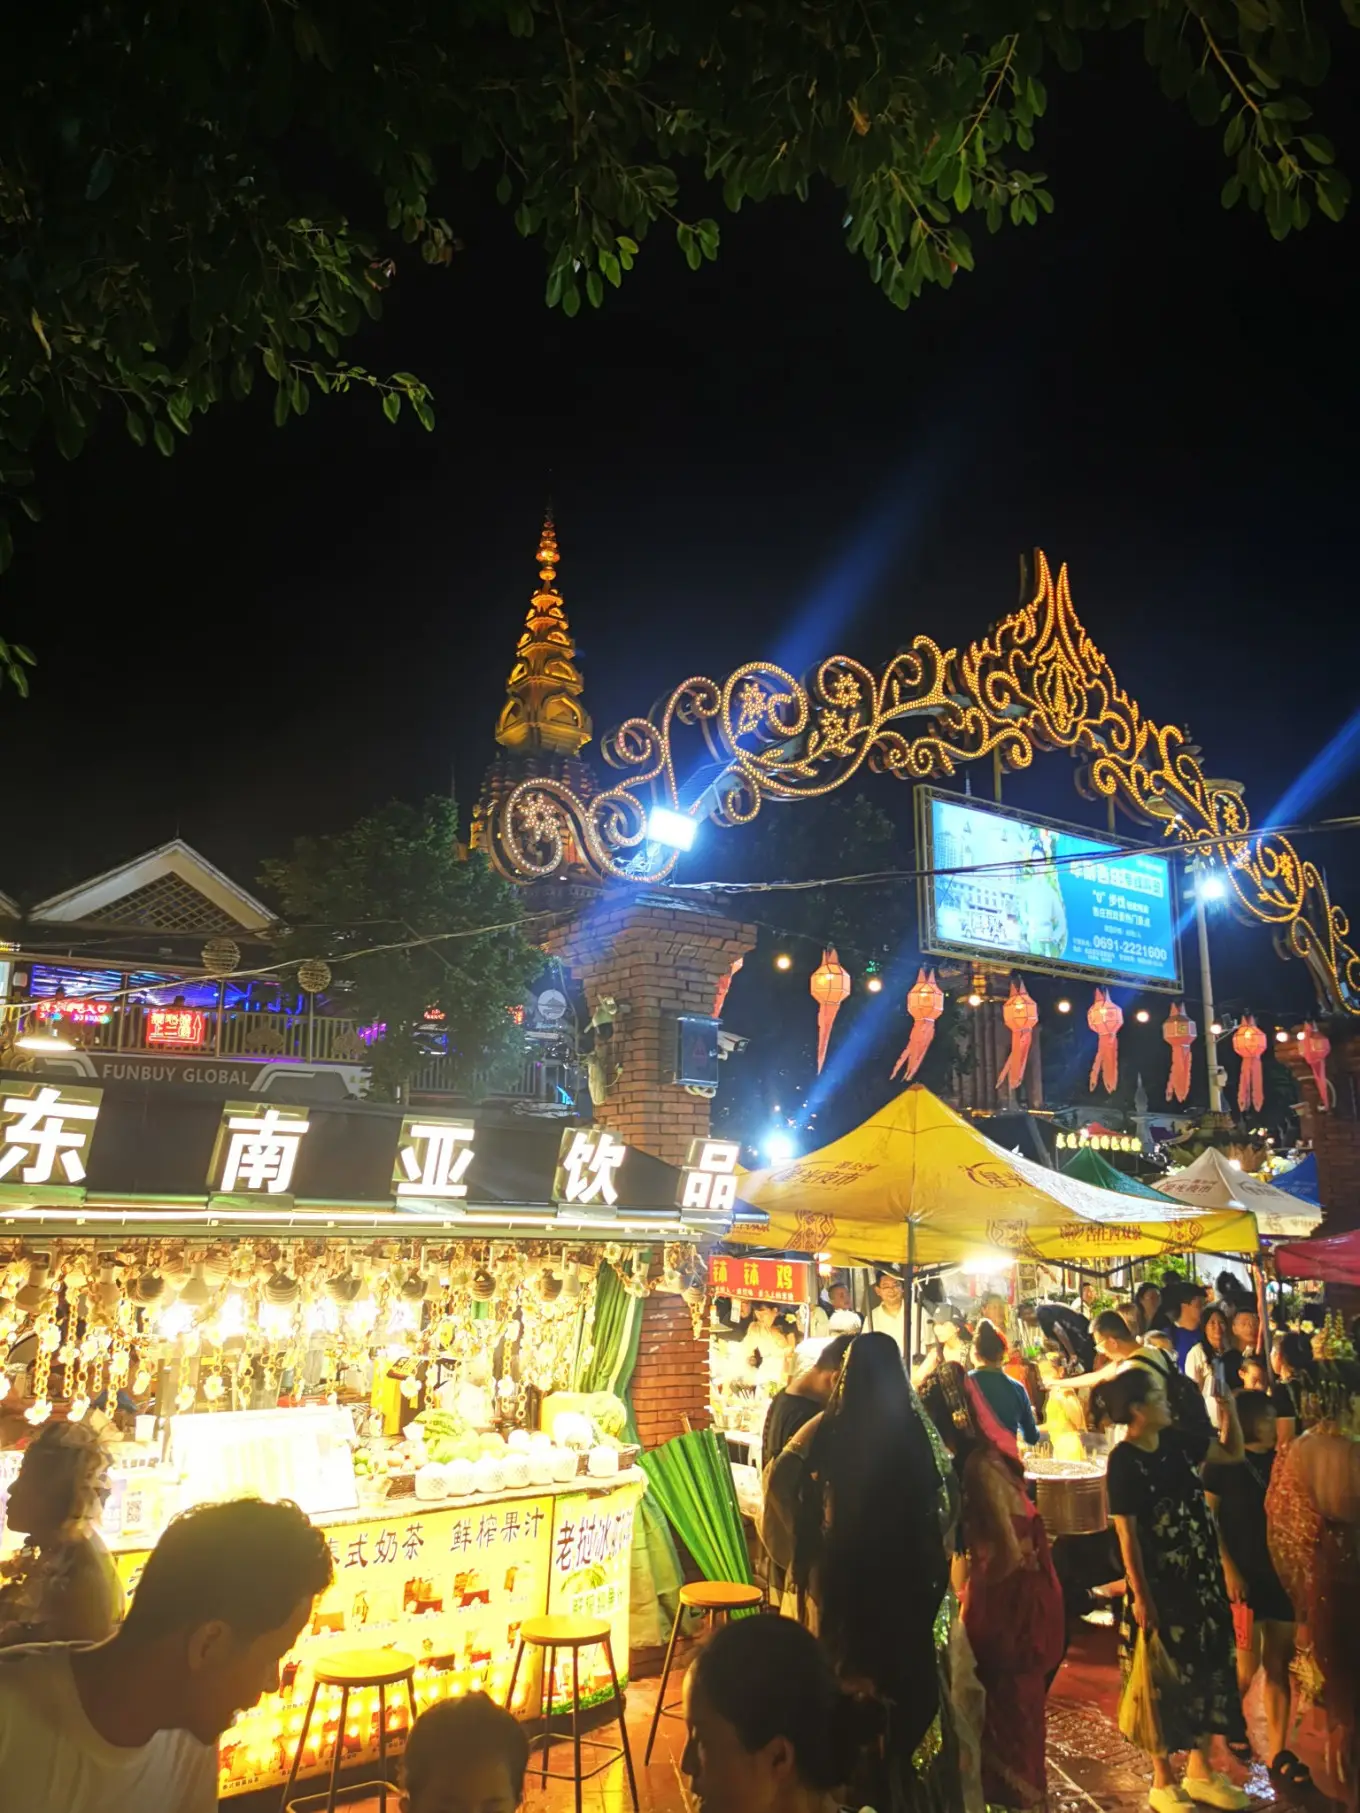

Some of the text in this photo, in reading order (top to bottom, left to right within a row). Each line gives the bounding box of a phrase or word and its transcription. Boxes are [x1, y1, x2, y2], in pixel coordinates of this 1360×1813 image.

[1093, 935, 1168, 961] 0691-2221600
[103, 1064, 250, 1085] FUNBUY GLOBAL
[0, 1087, 740, 1210] 东南亚饮品
[450, 1507, 545, 1552] 鲜榨果汁
